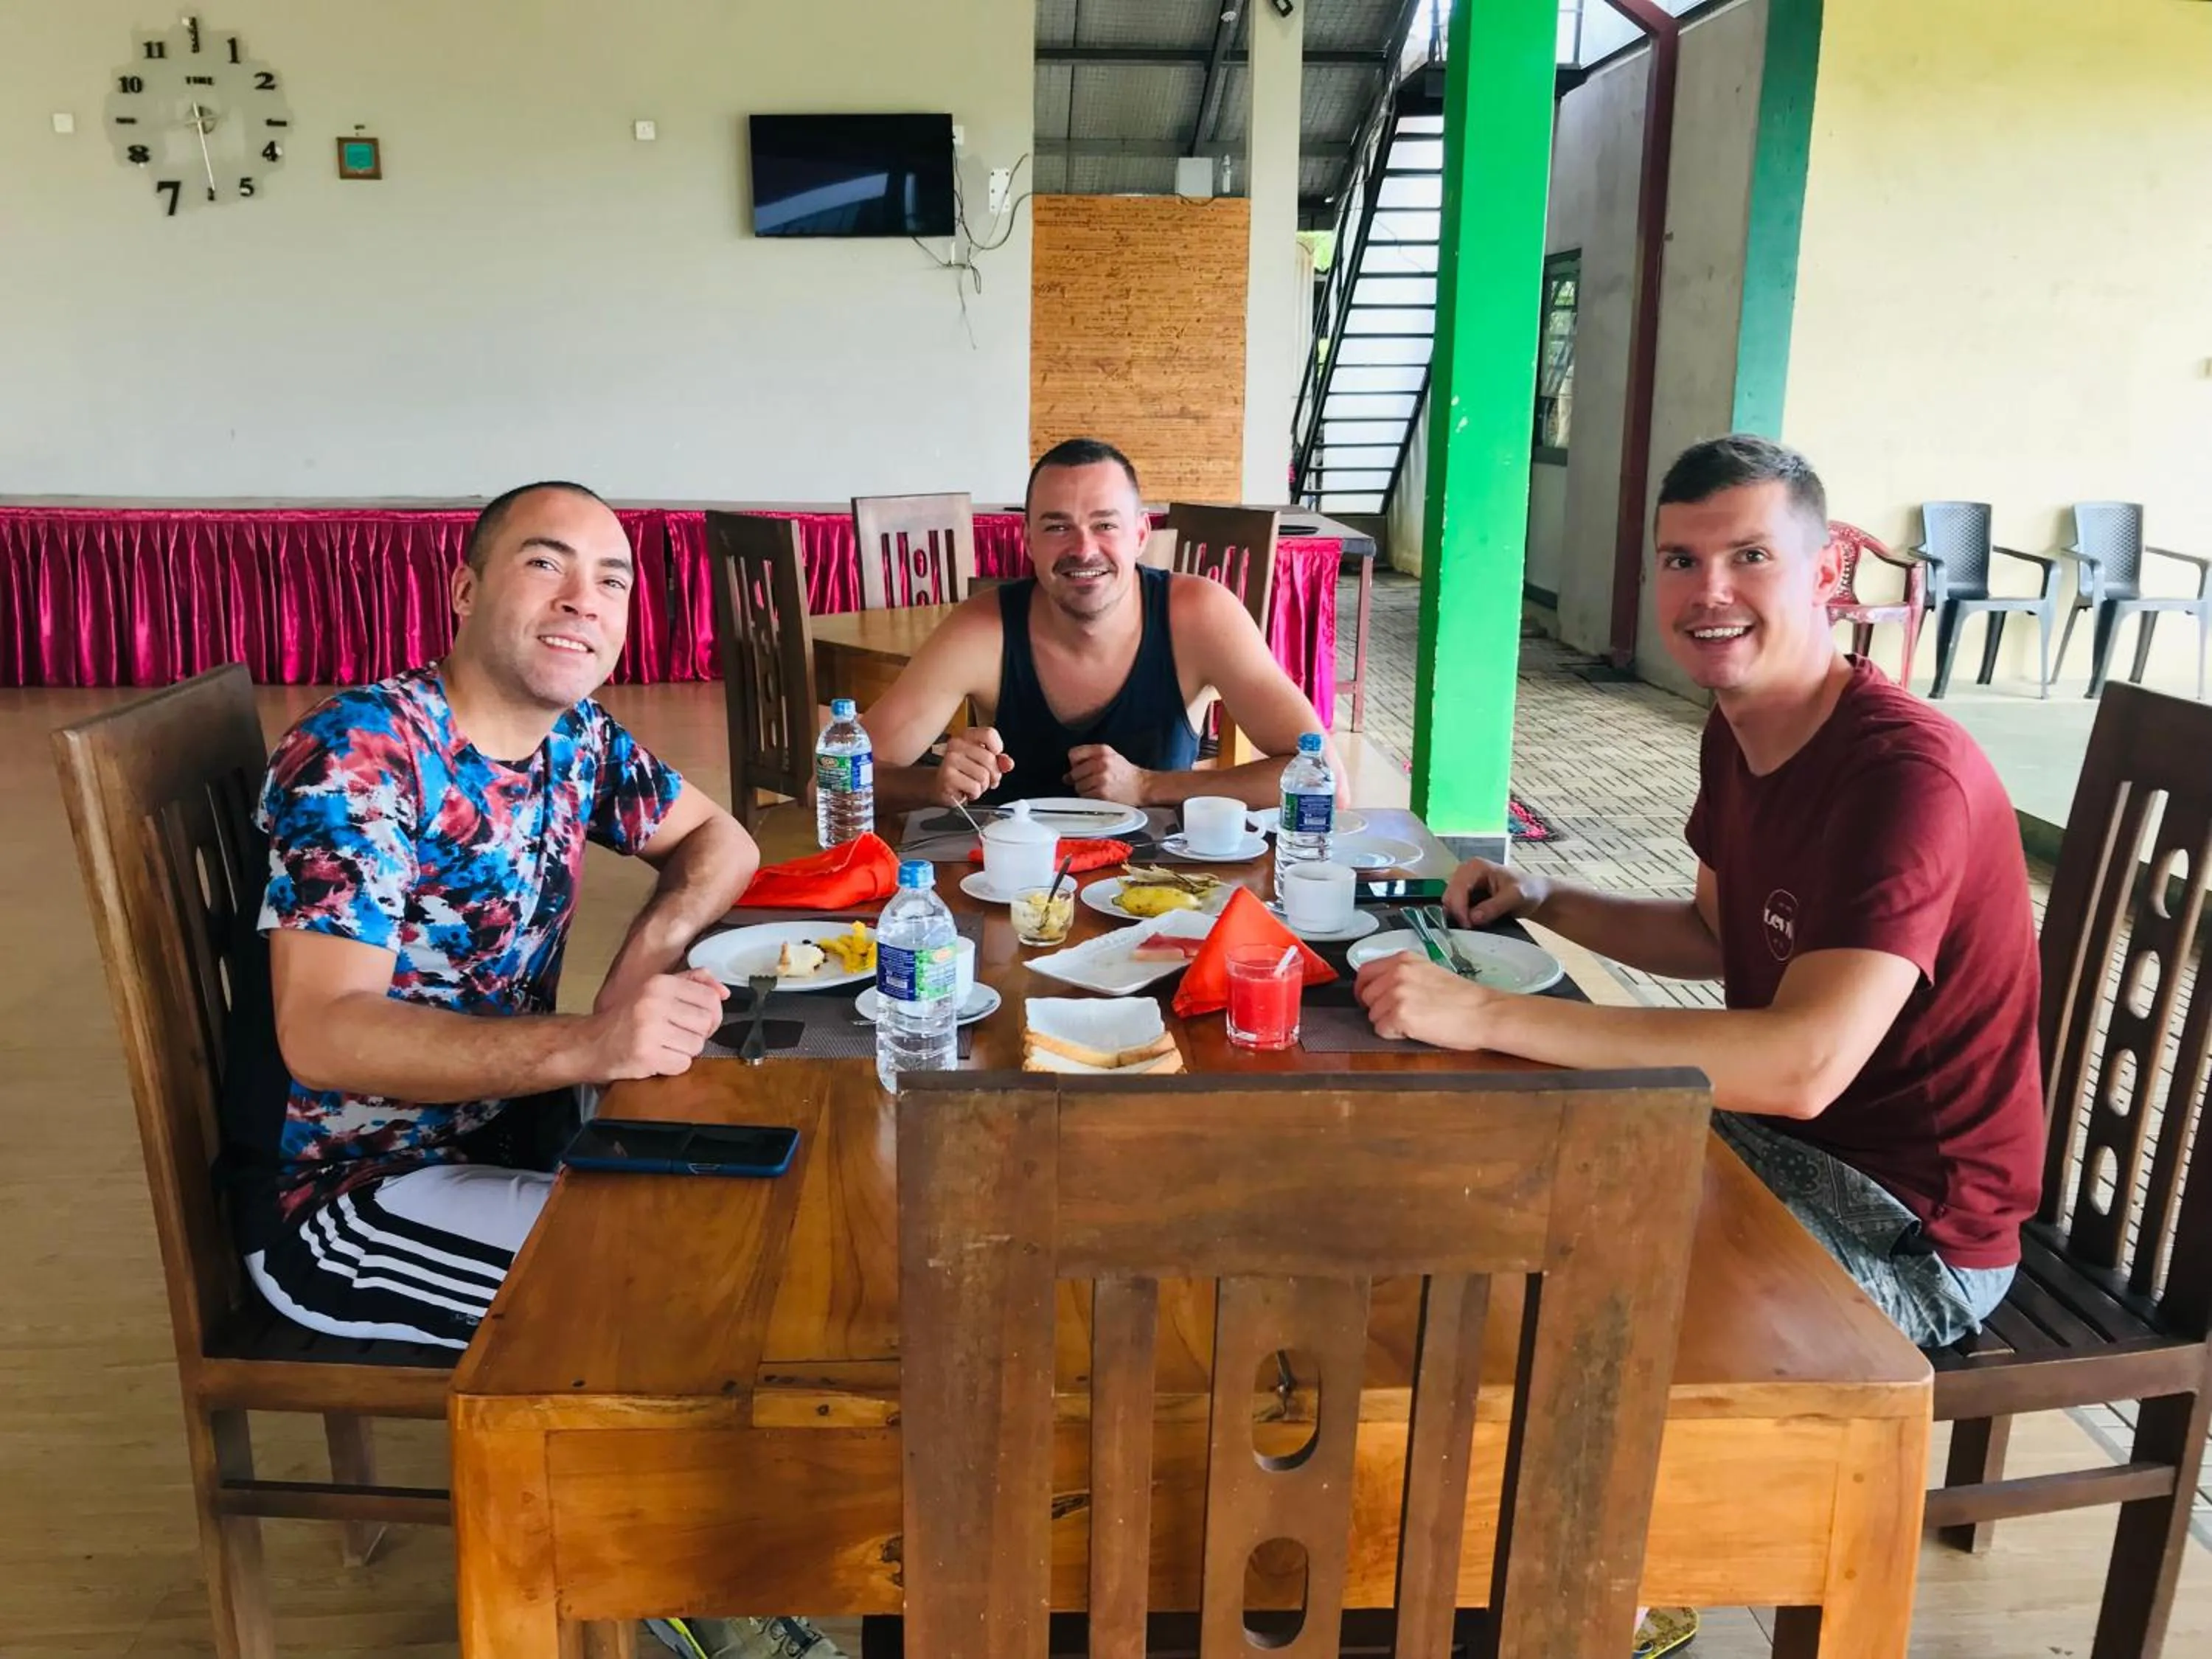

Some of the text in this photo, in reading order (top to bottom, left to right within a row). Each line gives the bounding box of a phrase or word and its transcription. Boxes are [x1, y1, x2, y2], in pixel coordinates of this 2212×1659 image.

[143, 41, 166, 59] 11
[227, 37, 241, 64] 1
[118, 76, 144, 94] 10
[254, 72, 276, 91] 2
[128, 145, 150, 164] 8
[262, 141, 279, 162] 4
[239, 177, 254, 197] 5
[157, 181, 181, 216] 7
